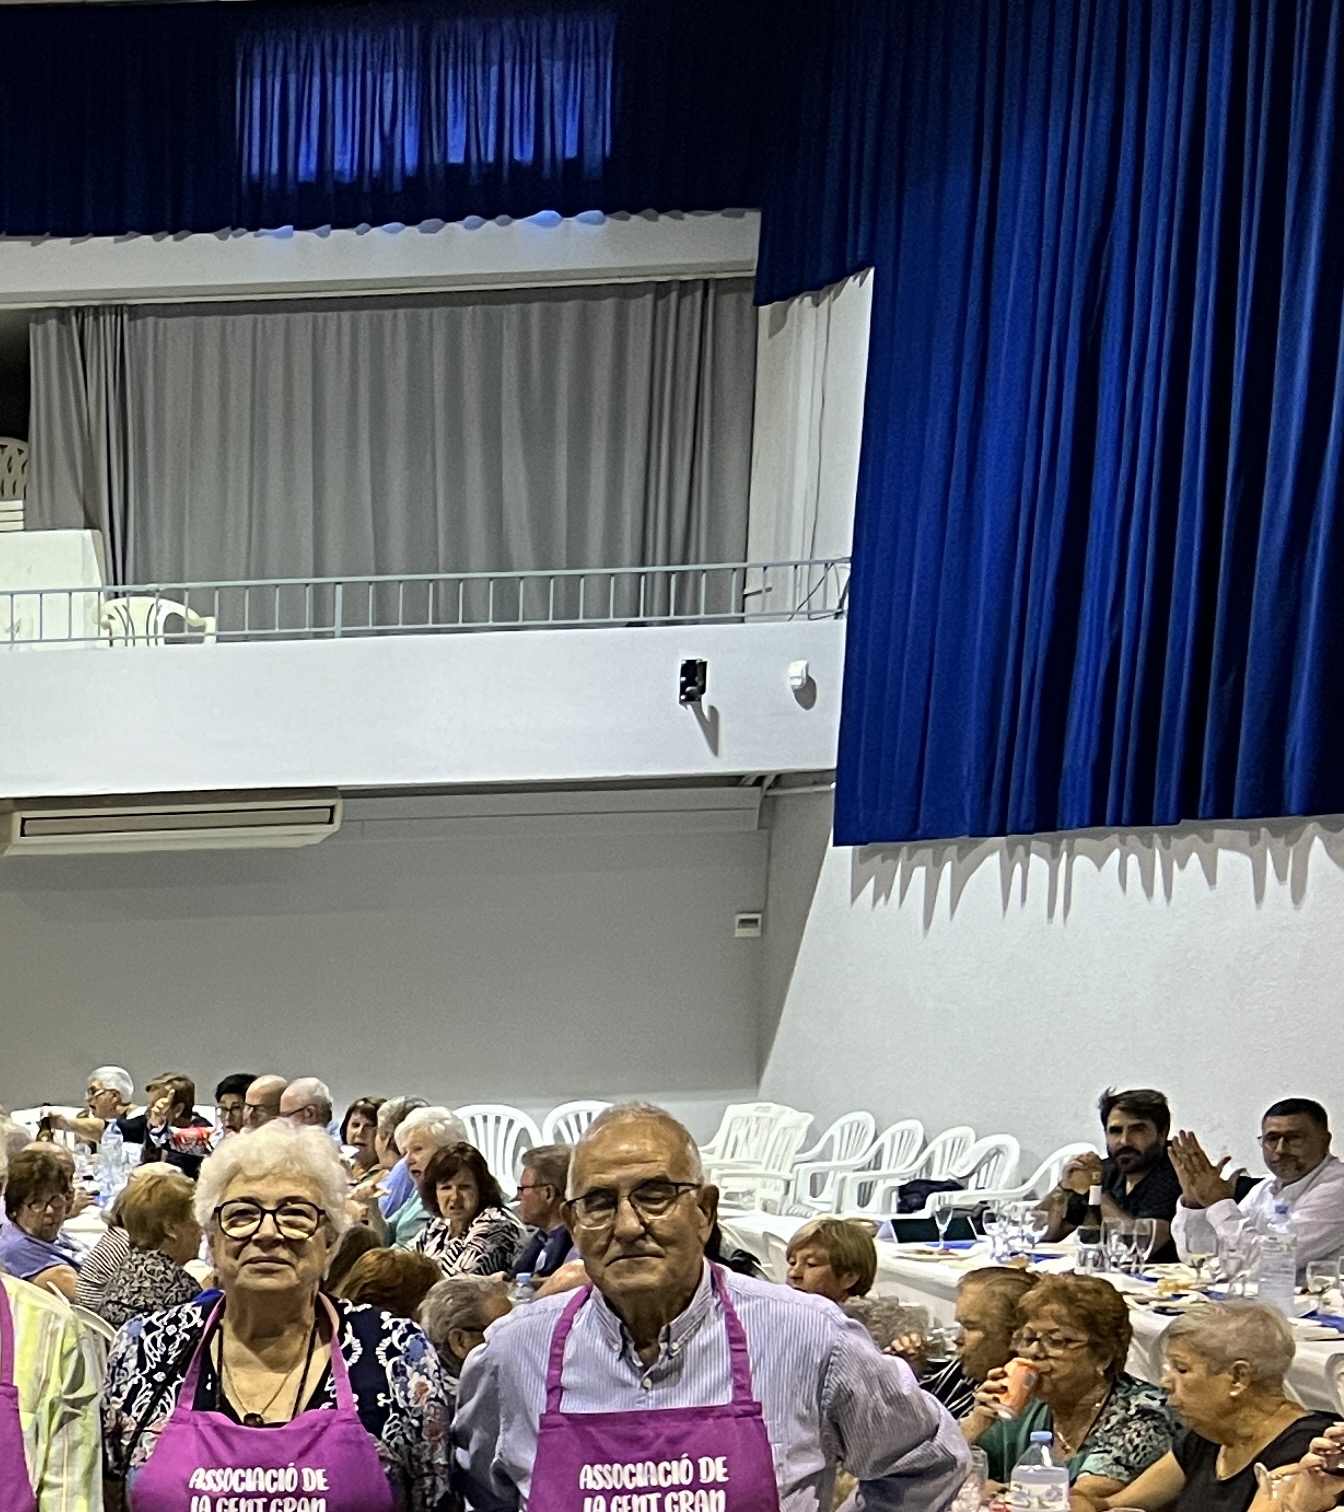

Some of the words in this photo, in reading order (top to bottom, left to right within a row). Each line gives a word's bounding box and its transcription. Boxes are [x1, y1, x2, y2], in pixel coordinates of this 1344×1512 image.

[188, 1462, 298, 1493] ASSOCIACIÓ
[301, 1467, 330, 1492] DE
[579, 1453, 694, 1490] ASSOCIACIÓ
[697, 1456, 730, 1484] DE
